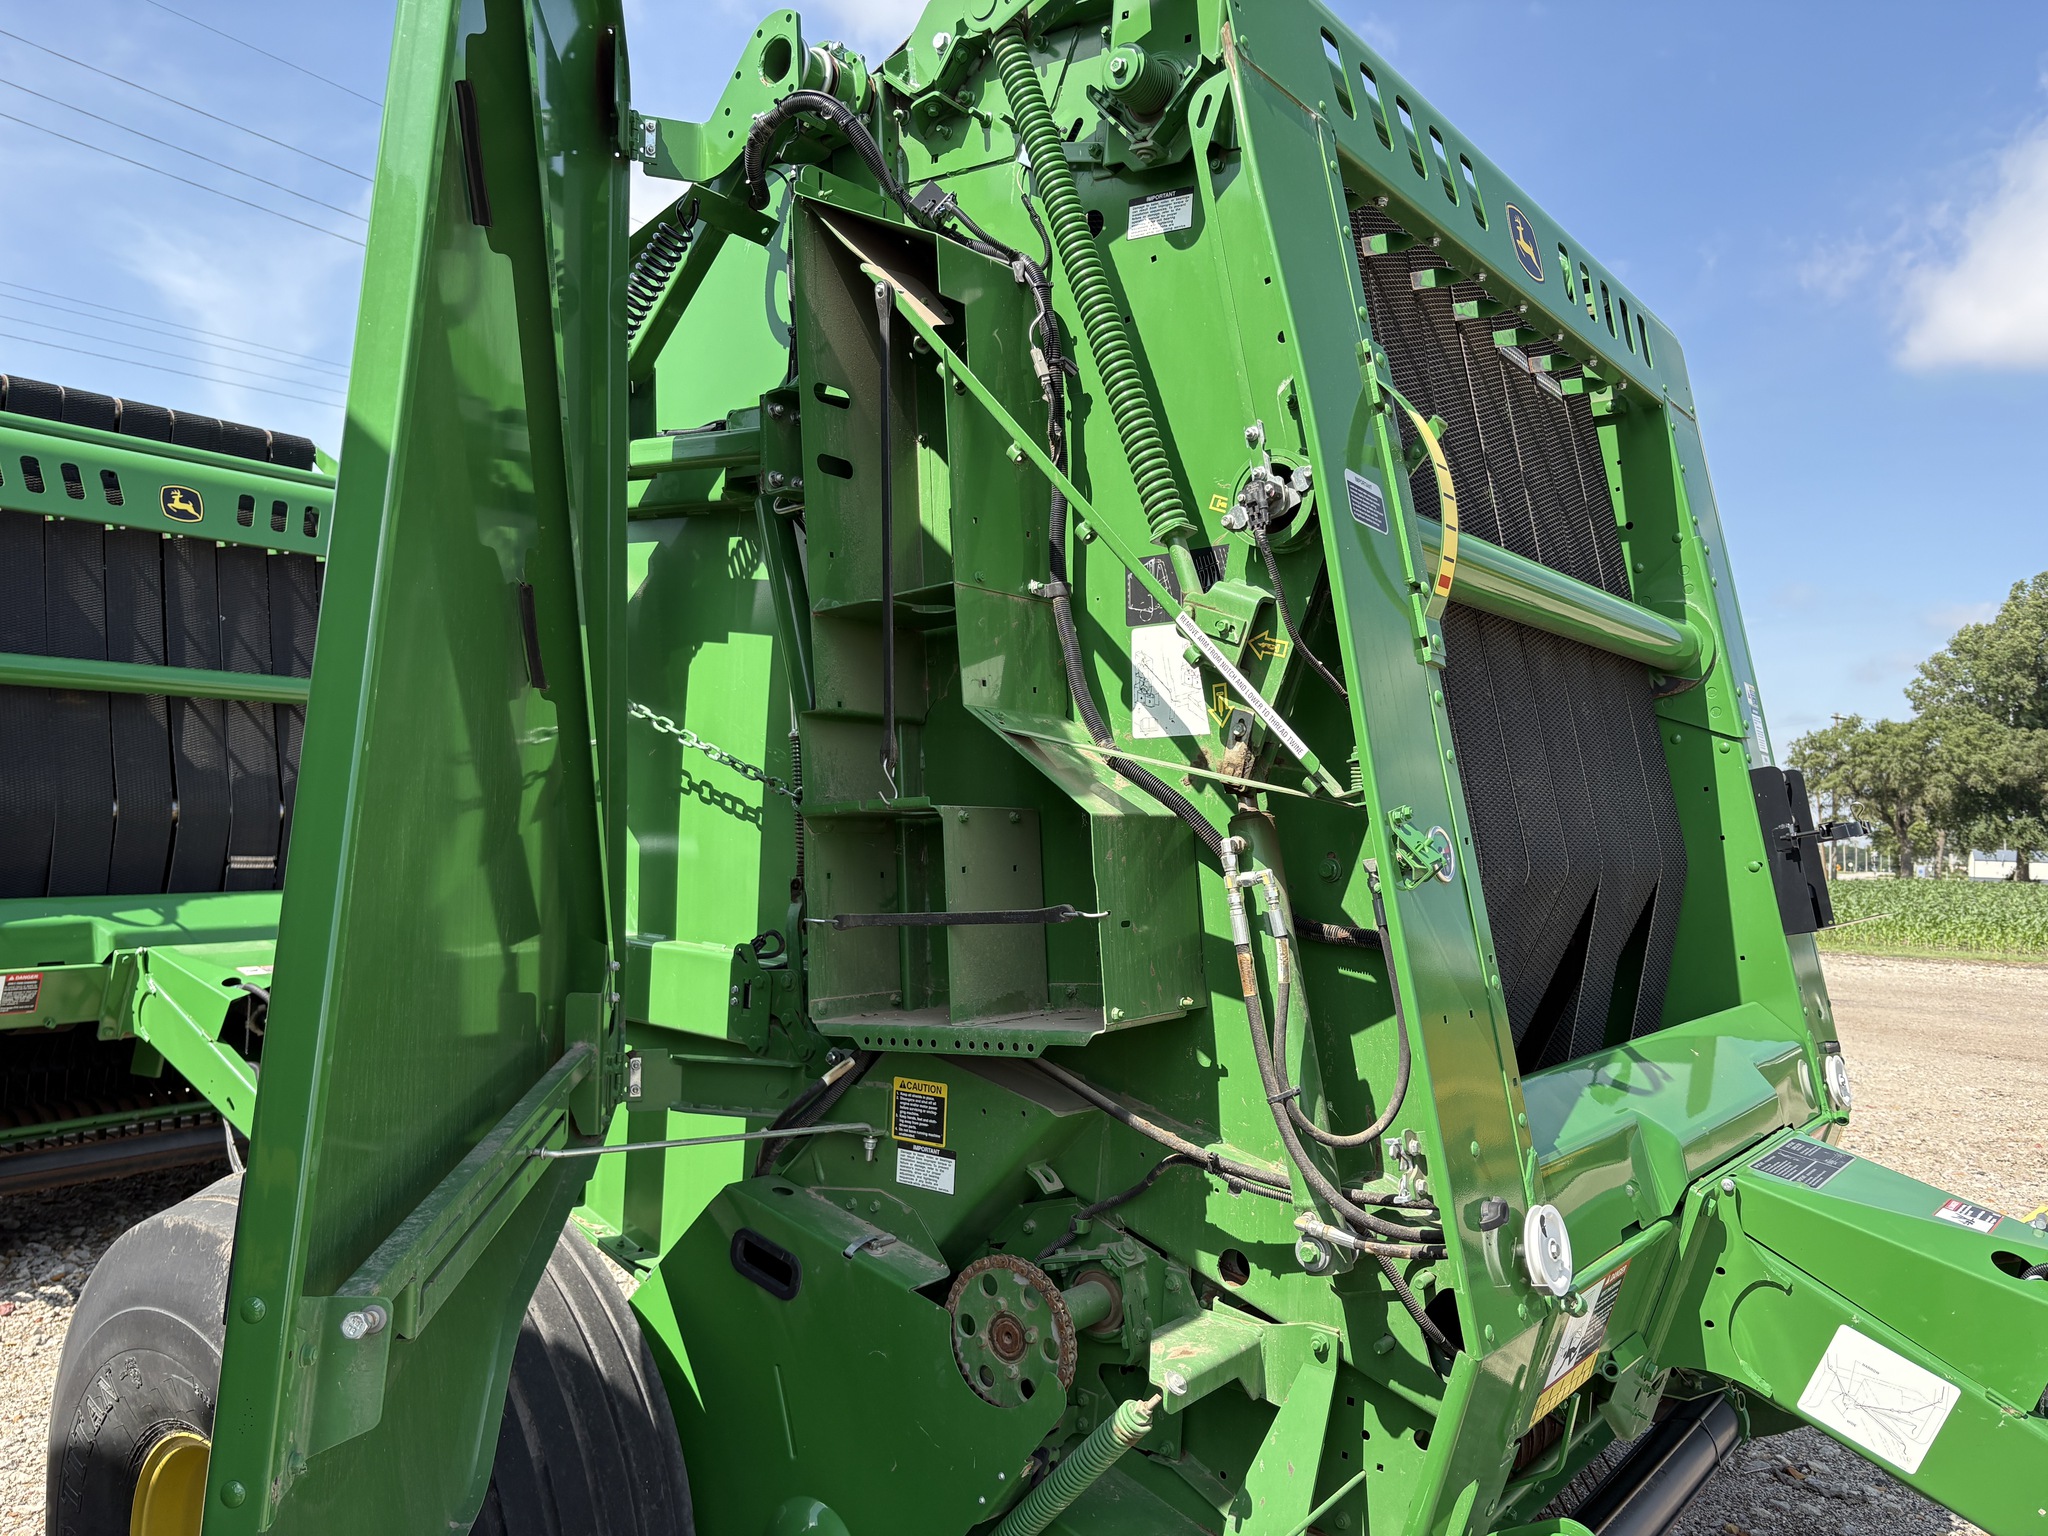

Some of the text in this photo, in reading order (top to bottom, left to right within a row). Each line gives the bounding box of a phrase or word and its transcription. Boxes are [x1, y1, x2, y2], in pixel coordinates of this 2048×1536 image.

[1146, 191, 1176, 202] IMPORTANT
[1180, 614, 1304, 755] REMOVE ARM FROM NOTCH AND LOWER TO THREAD TWINE
[906, 1081, 942, 1095] CAUTION
[913, 1145, 940, 1155] IMPORTANT
[61, 1363, 120, 1514] TITAN
